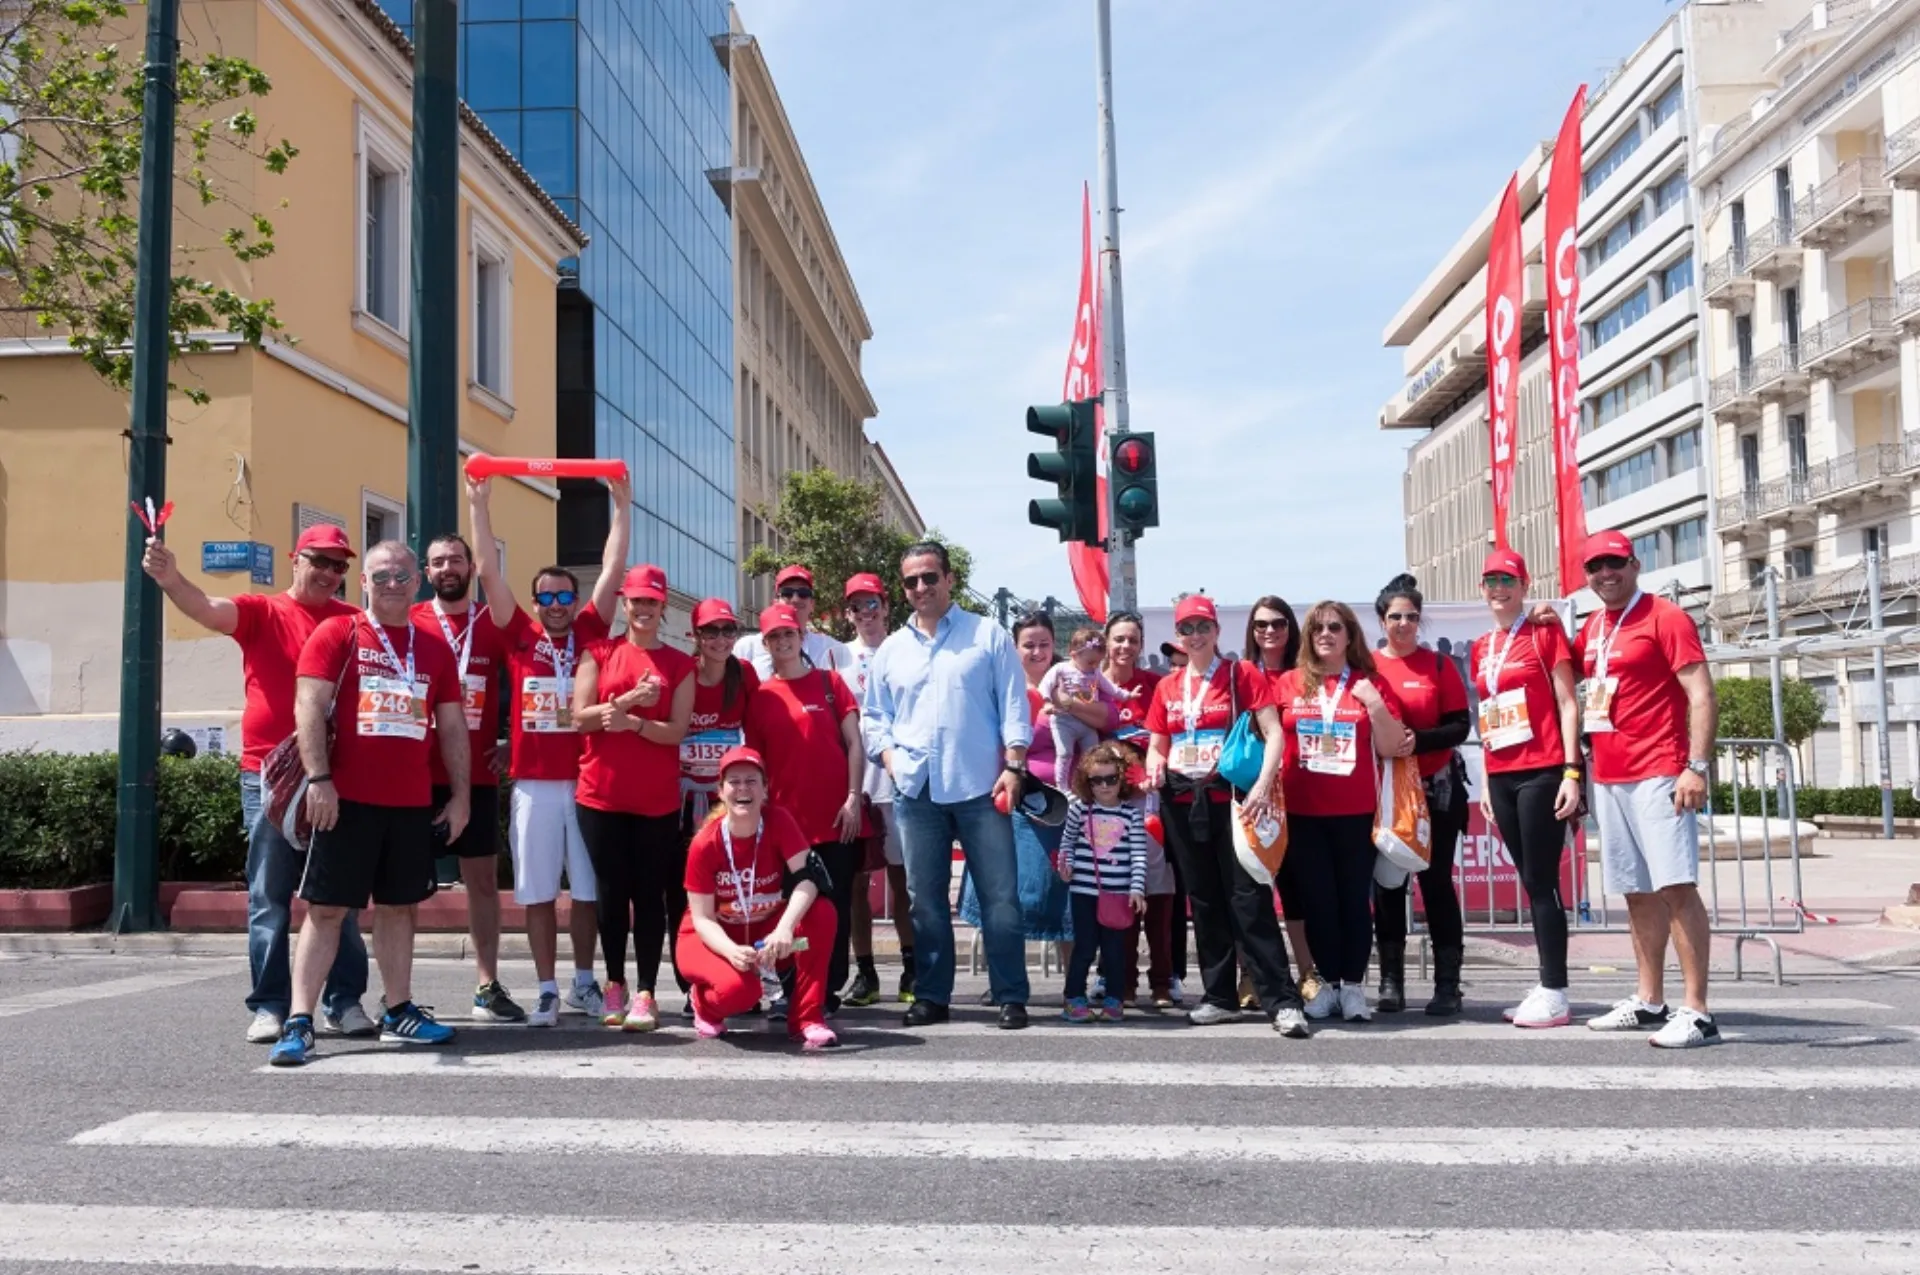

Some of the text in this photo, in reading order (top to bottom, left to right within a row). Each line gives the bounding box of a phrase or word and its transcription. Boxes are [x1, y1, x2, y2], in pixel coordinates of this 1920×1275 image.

[358, 647, 396, 667] ERG
[369, 692, 410, 713] 946
[690, 712, 719, 725] RGO
